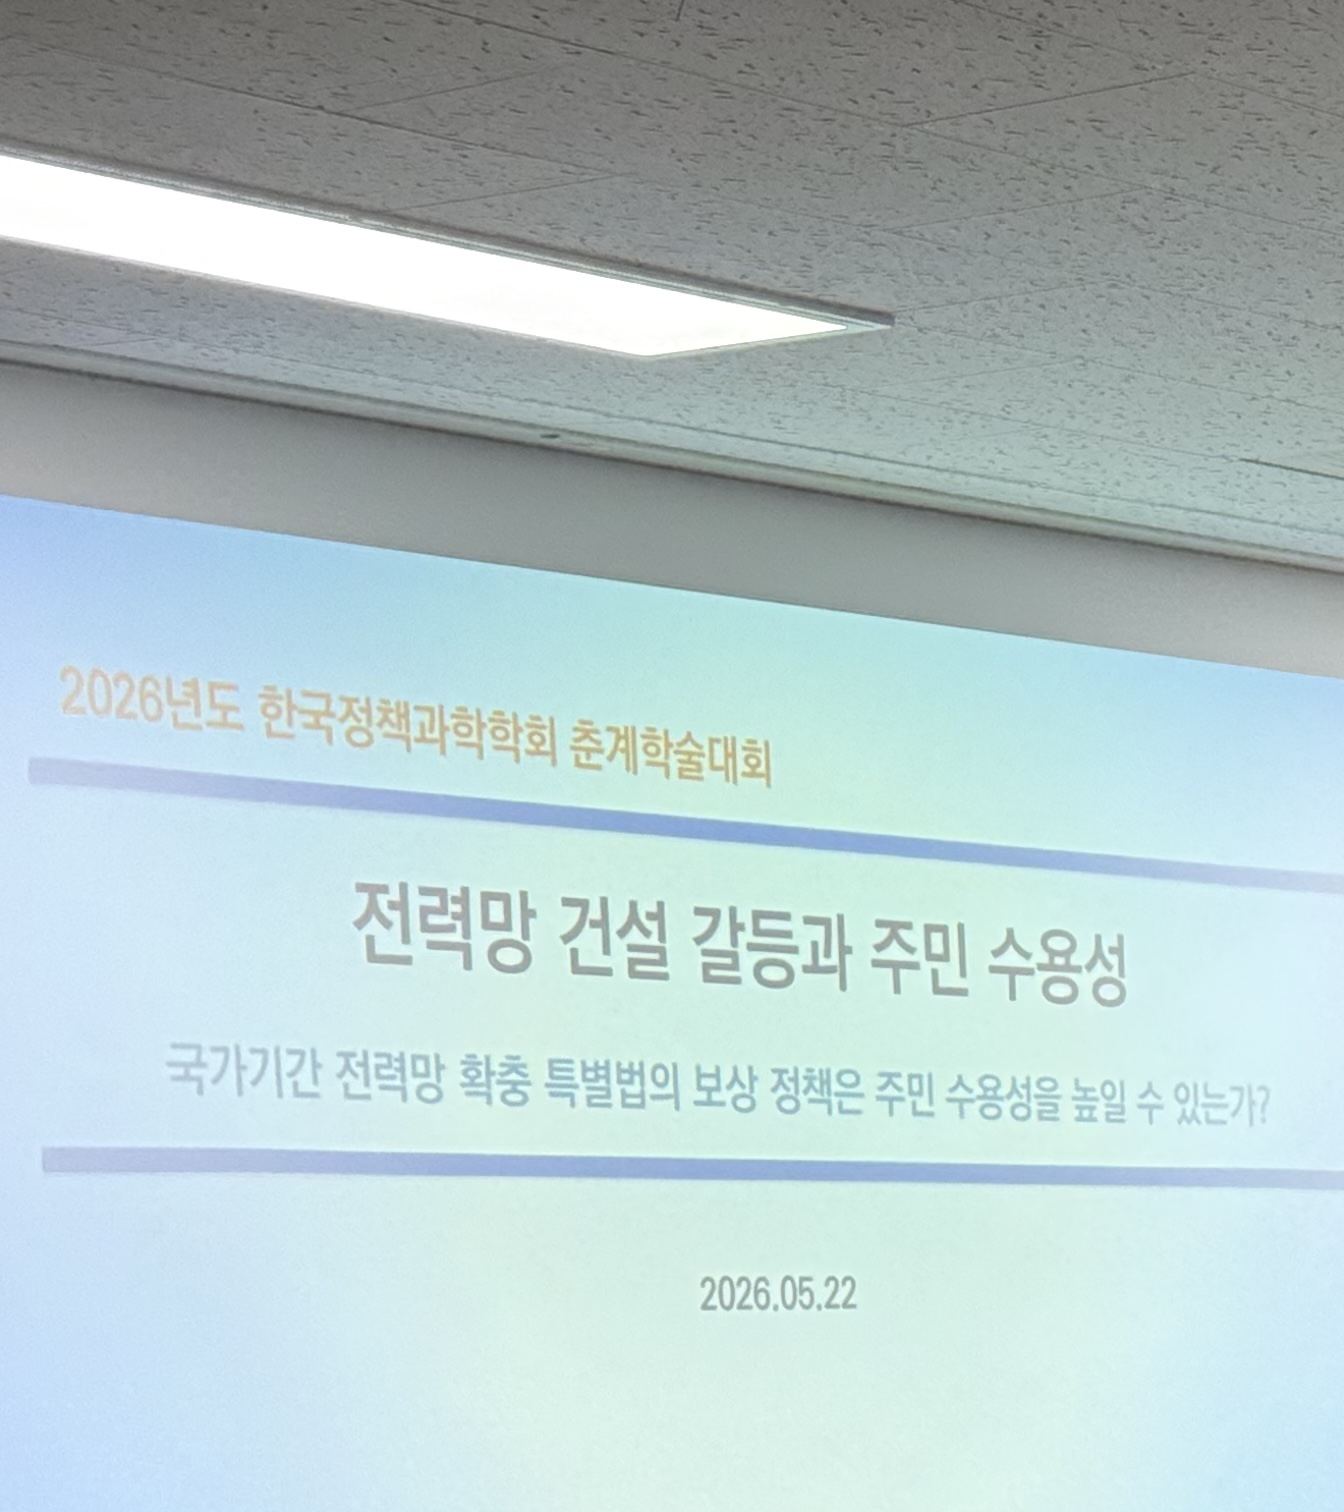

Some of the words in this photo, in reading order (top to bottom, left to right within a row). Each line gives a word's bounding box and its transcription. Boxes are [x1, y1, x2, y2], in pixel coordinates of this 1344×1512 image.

[60, 665, 244, 732] 2026년도
[257, 684, 558, 768] 한국정책과학학회
[569, 718, 772, 788] 춘계학술대회
[352, 880, 537, 975] 전력망
[559, 895, 671, 982] 건설
[692, 904, 854, 993] 갈등과
[870, 918, 969, 998] 주민
[988, 926, 1127, 1008] 수용성
[165, 1041, 323, 1100] 국가기간
[335, 1049, 446, 1105] 전력망
[459, 1053, 533, 1107] 확충
[544, 1057, 681, 1111] 특별법의
[692, 1062, 759, 1114] 보상
[769, 1064, 866, 1117] 정책은
[874, 1070, 936, 1119] 주민
[945, 1072, 1062, 1123] 수용성을
[1070, 1077, 1128, 1125] 높일
[1136, 1080, 1166, 1126] 수
[1172, 1080, 1272, 1129] 있는가?
[699, 1274, 859, 1312] 2026.05.22
